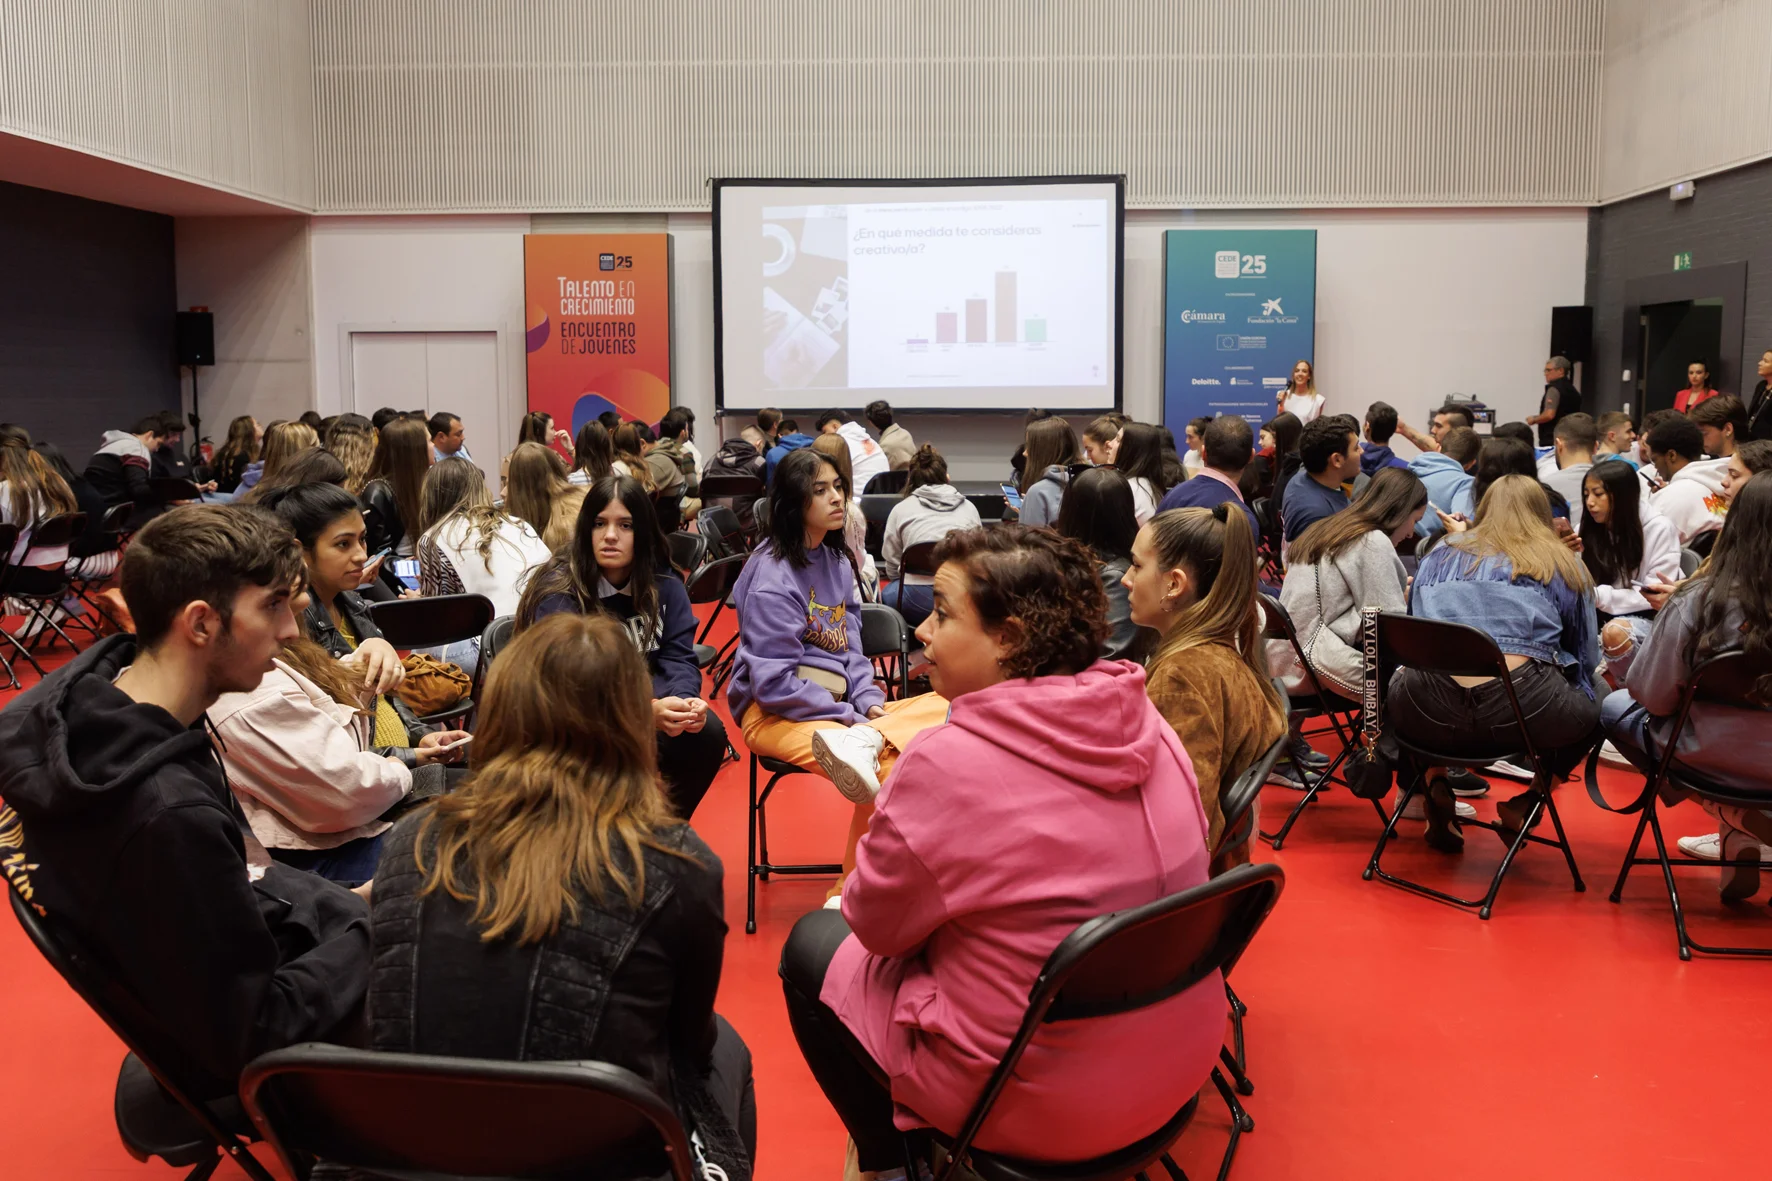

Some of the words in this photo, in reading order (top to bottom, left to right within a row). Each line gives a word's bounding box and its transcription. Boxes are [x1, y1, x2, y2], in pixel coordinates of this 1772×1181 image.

[853, 228, 875, 241] ¿En
[878, 227, 902, 240] qué
[904, 225, 953, 238] medida
[955, 226, 968, 237] te
[971, 224, 1043, 237] consideras
[853, 243, 926, 256] creativo/a?
[616, 256, 633, 268] 25
[1241, 255, 1267, 274] 25
[557, 276, 615, 297] TALENTO
[619, 281, 635, 297] EN
[560, 298, 635, 315] CRECIMIENTO
[561, 322, 636, 338] ENCUENTRO
[562, 339, 576, 354] DE
[579, 339, 636, 354] JOVENES
